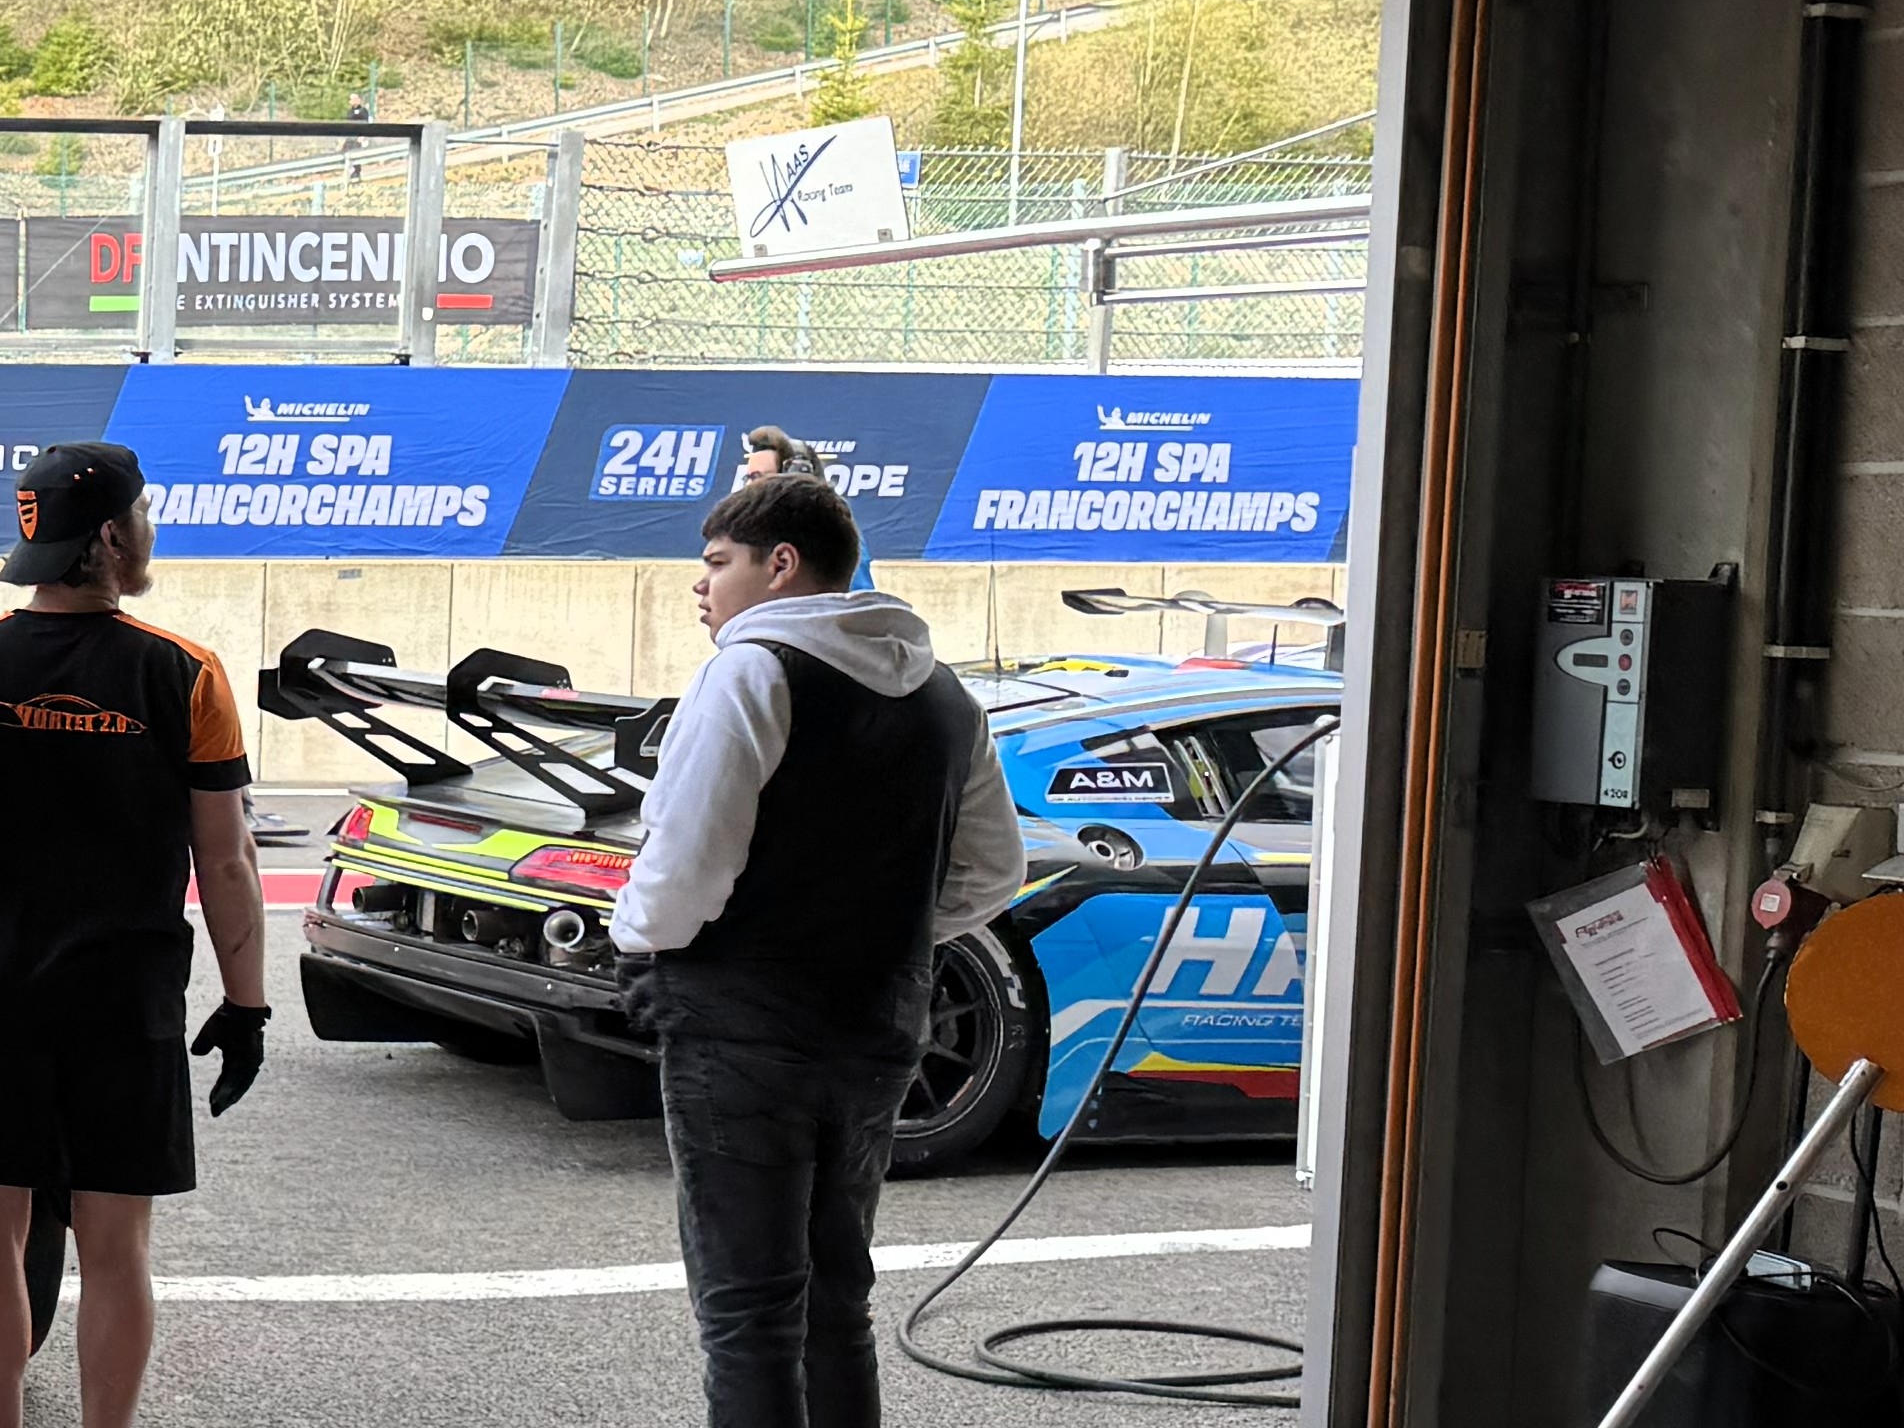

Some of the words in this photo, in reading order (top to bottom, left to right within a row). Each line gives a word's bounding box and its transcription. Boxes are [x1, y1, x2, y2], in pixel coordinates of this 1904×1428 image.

[829, 183, 853, 197] Team
[91, 232, 495, 285] DFNTINCENIO
[195, 293, 320, 311] EXTINGUISHER
[276, 403, 371, 417] MICHELIN
[1125, 412, 1212, 426] MICHELIN
[218, 434, 300, 476] 12H
[306, 434, 393, 477] SPA
[603, 430, 718, 477] 24H
[1073, 442, 1148, 483] 12H
[1153, 443, 1232, 484] SPA
[598, 476, 706, 497] SERIES
[144, 483, 490, 527] RANCORCHAMPS
[972, 489, 1321, 533] FRANCORCHAMPS
[1069, 770, 1154, 789] A&M
[1181, 1014, 1274, 1027] RACING
